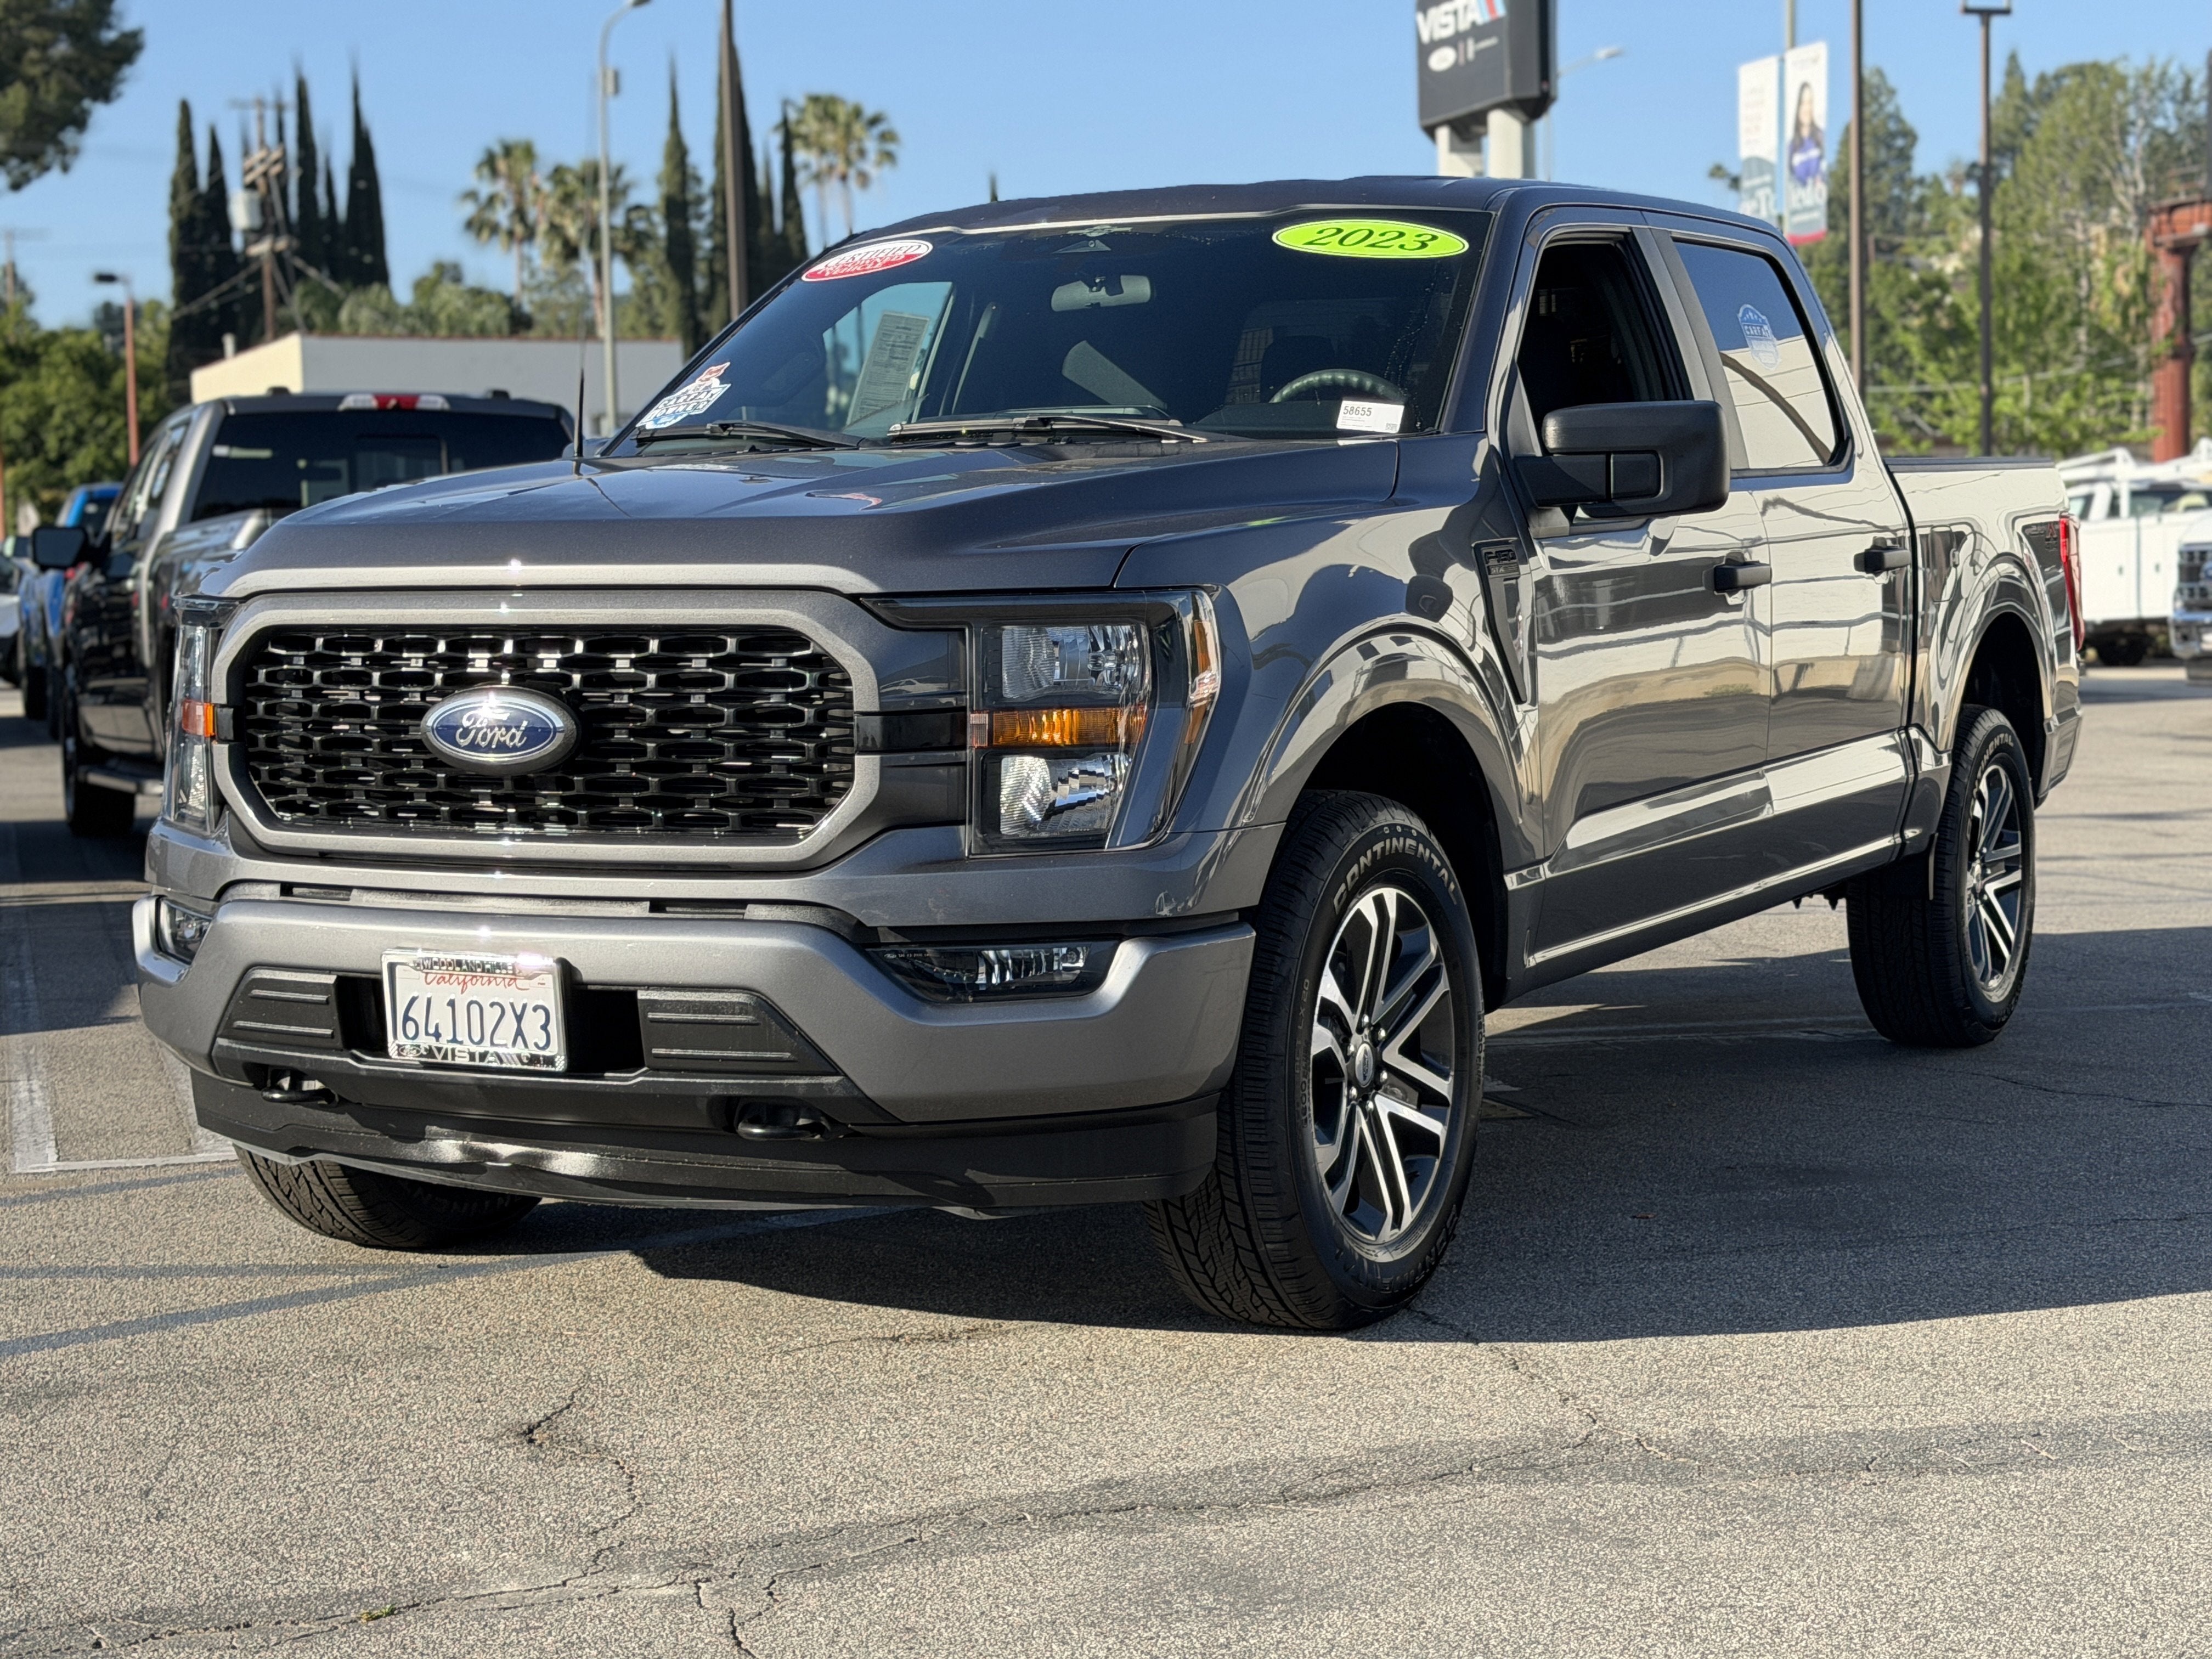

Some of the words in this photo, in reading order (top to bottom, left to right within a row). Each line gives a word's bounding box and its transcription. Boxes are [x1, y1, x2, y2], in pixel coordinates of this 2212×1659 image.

[1415, 0, 1483, 44] VISTA
[1302, 227, 1439, 251] 2023
[824, 244, 922, 268] CERTIFIED
[658, 386, 723, 409] CARFAX
[1343, 406, 1372, 417] 58655
[456, 708, 527, 748] Ford
[1333, 837, 1457, 915] CONTINENTAL
[423, 958, 483, 973] WOODLAND
[424, 973, 530, 994] California
[402, 992, 551, 1051] 64102X3
[431, 1044, 500, 1065] VISTA
